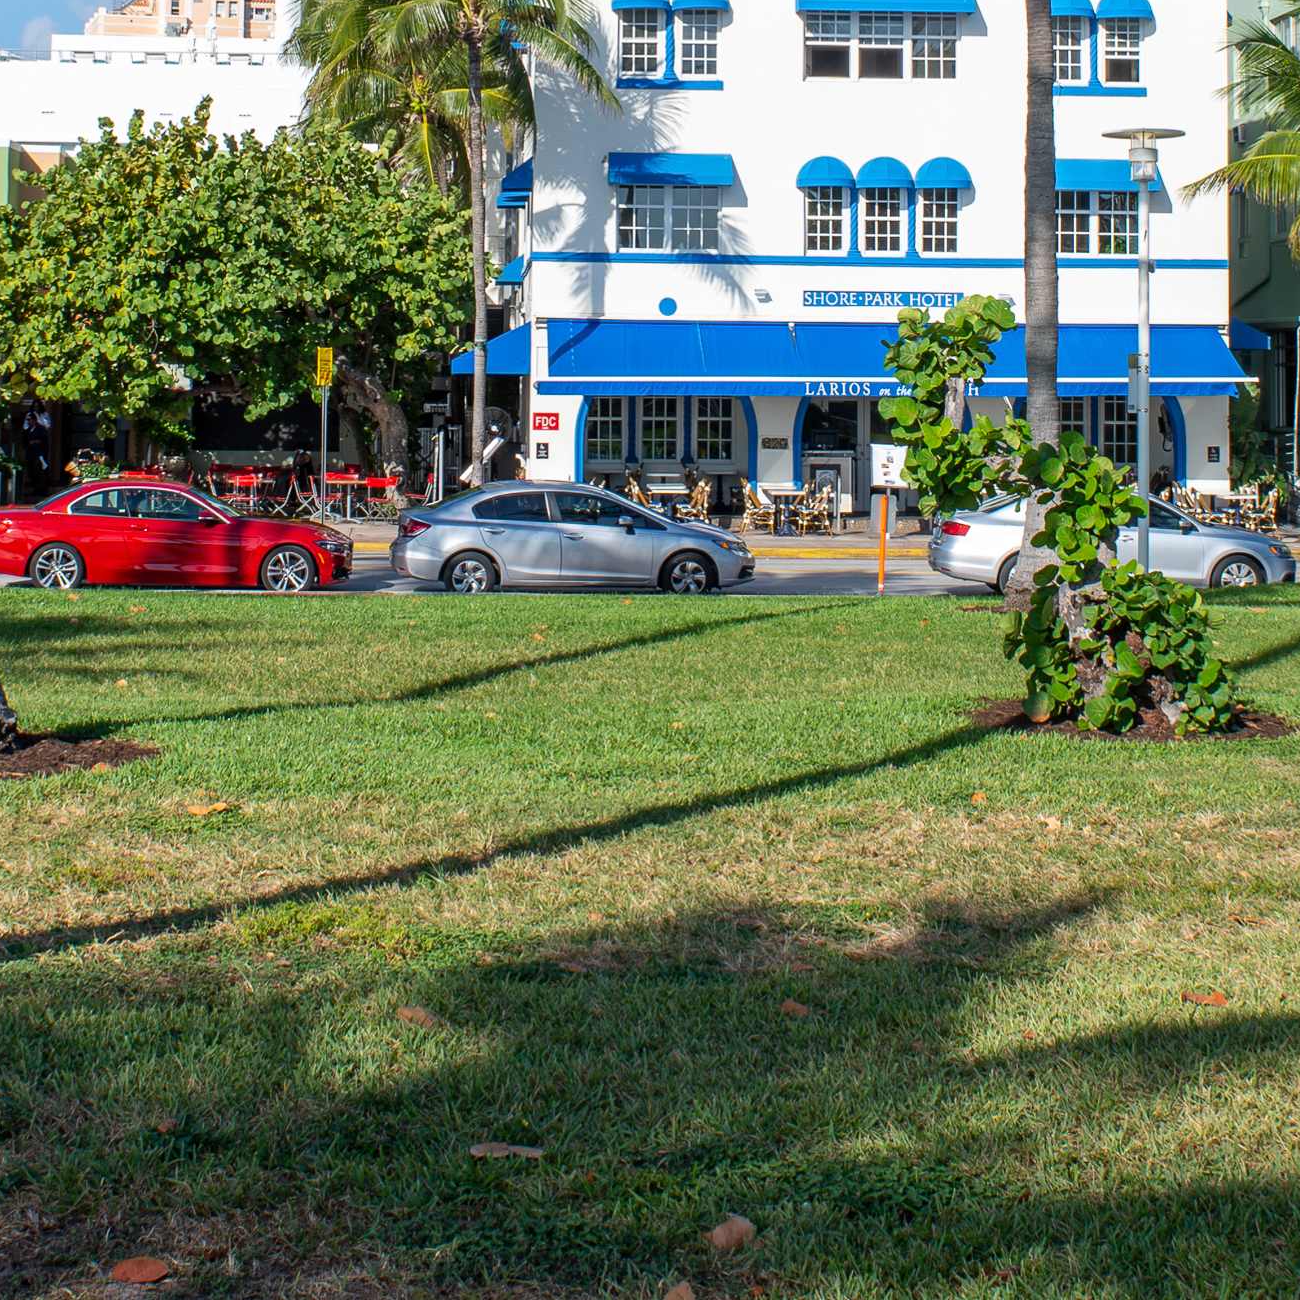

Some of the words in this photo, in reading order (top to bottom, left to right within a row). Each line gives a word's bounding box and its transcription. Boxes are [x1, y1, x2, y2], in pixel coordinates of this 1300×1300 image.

[805, 382, 871, 396] LARIOS
[879, 388, 891, 396] on
[896, 385, 913, 396] the
[535, 416, 557, 427] FDC
